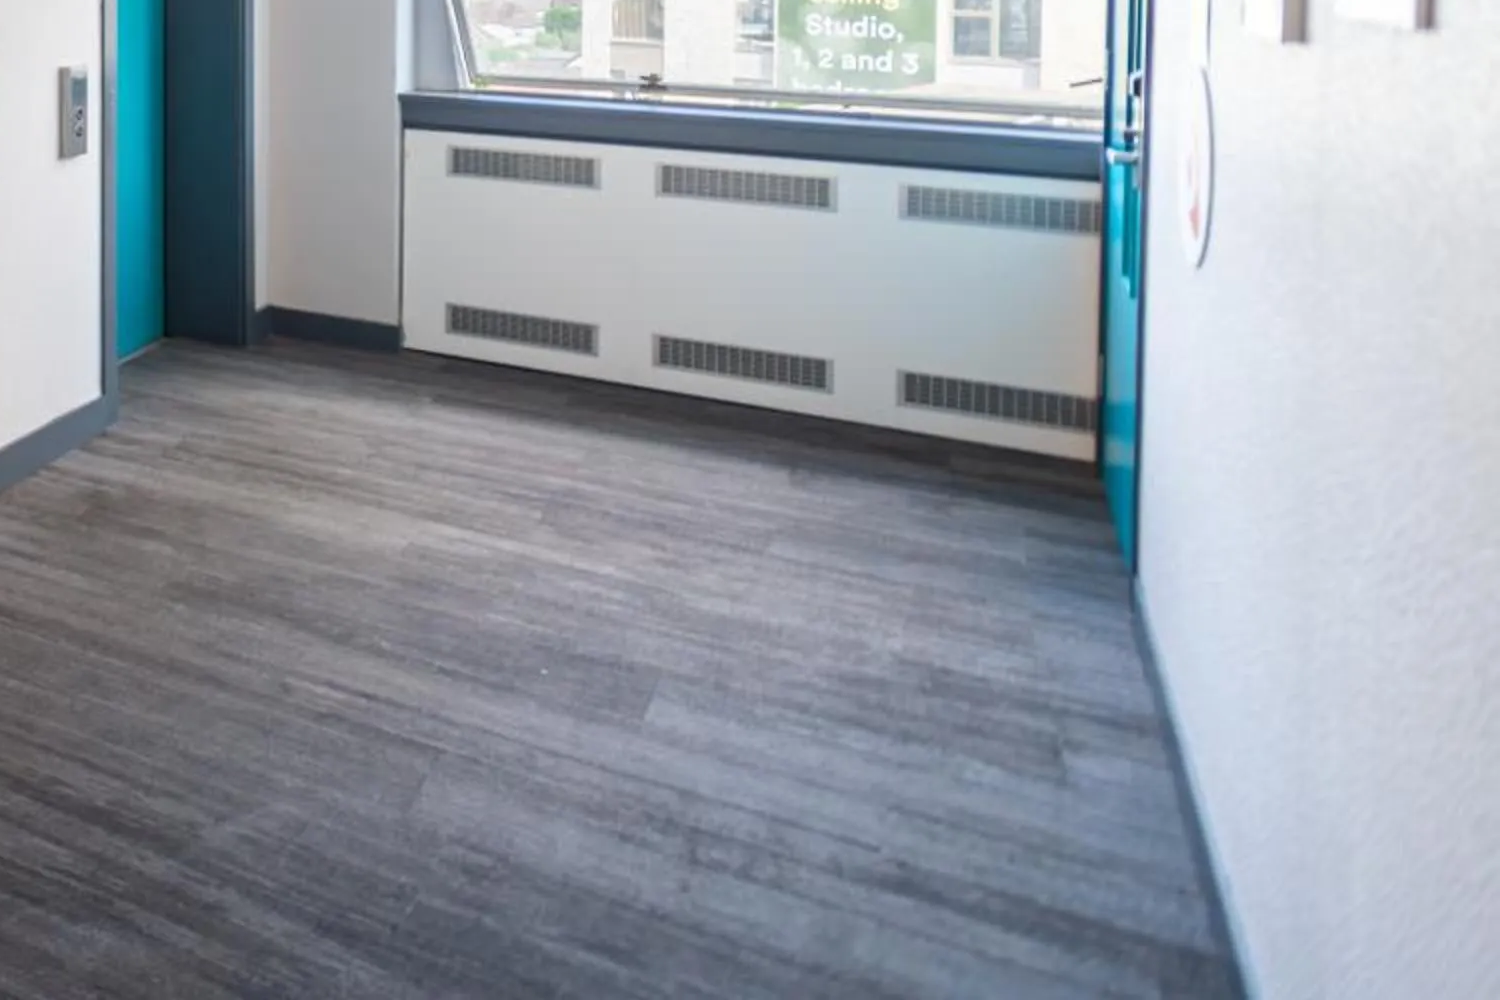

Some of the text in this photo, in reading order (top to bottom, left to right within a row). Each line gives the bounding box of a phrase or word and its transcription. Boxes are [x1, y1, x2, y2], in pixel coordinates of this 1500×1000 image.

[804, 12, 904, 43] Studio,
[792, 48, 920, 75] 1, 2 and 3
